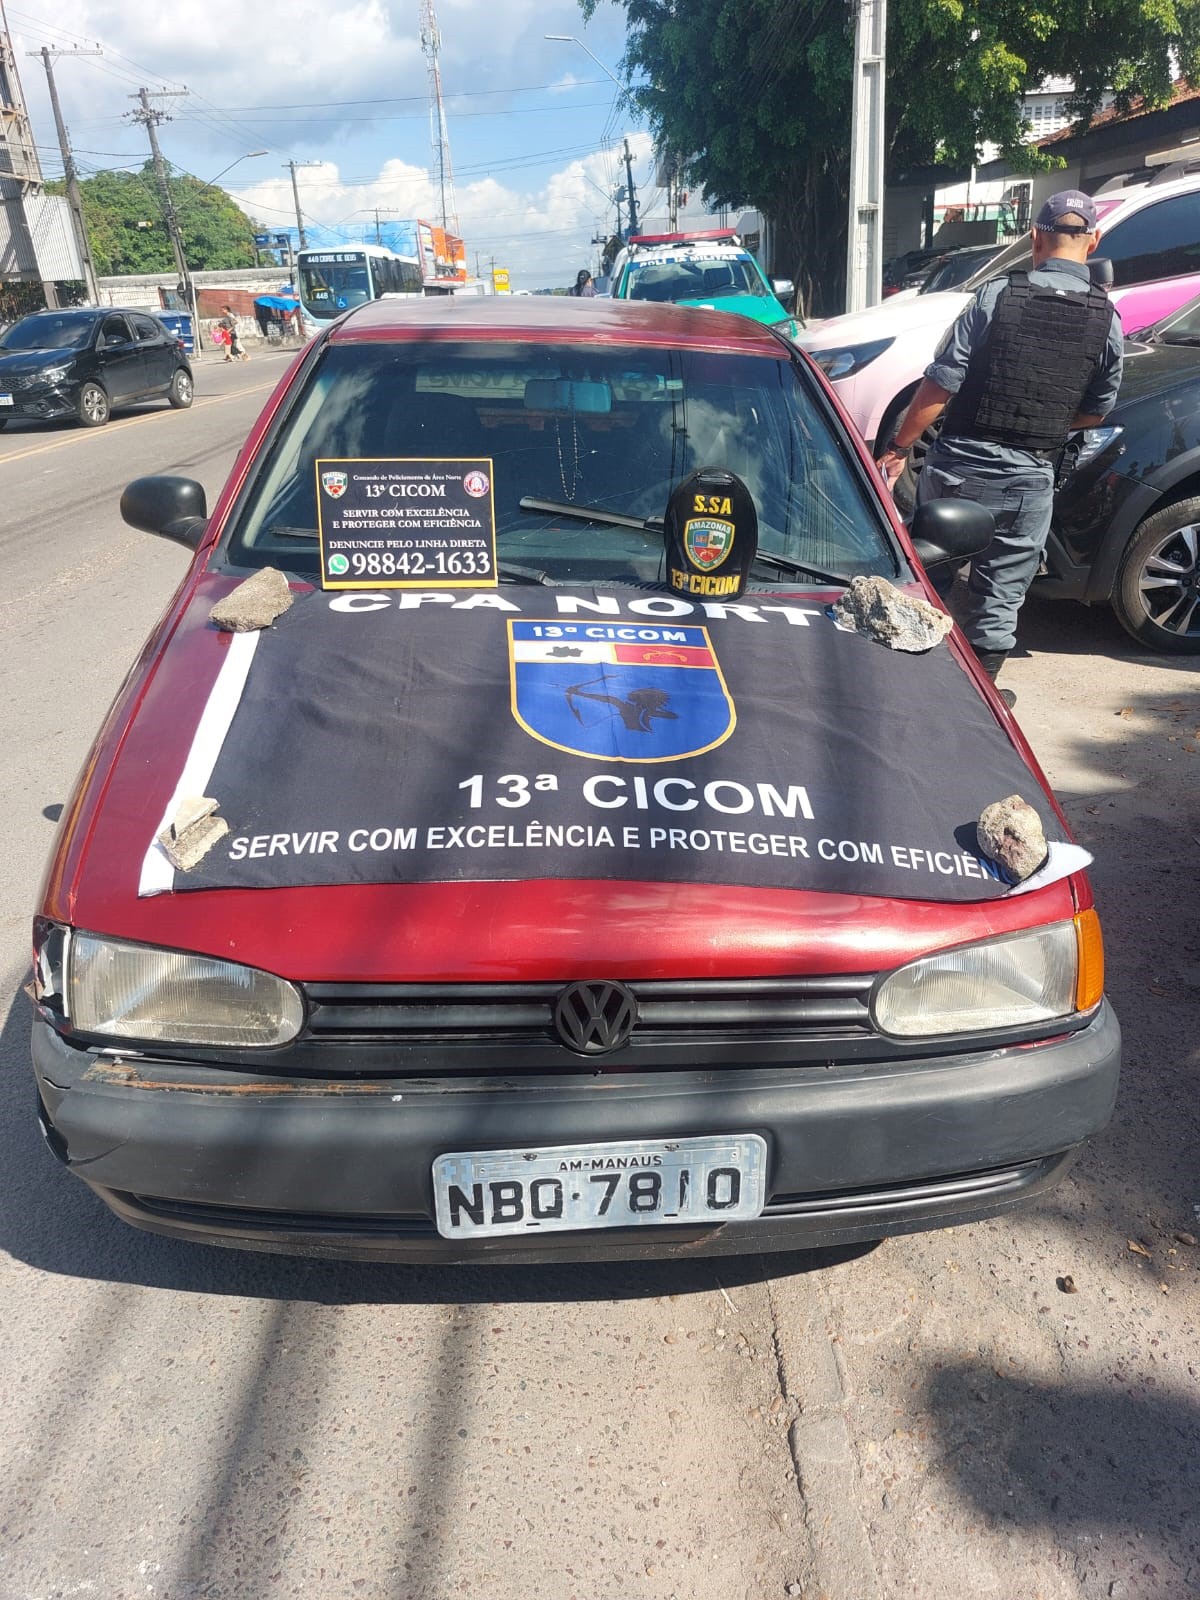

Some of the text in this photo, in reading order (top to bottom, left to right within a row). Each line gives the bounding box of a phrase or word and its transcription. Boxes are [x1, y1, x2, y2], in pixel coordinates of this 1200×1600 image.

[690, 254, 738, 262] MILITAR
[366, 484, 446, 497] 13ª CICOM
[343, 507, 470, 517] SERVIR COM EXCELÊNCIA
[333, 518, 482, 529] E PROTEGER COM EFICIÊNCIA
[689, 521, 732, 534] AMAZONAS
[329, 541, 384, 549] DENUNCIE
[415, 540, 448, 548] LINHA
[450, 539, 487, 548] DIRETA
[352, 552, 490, 575] 98842-1633
[672, 568, 741, 595] 13ª CICOM
[329, 593, 858, 633] CPA NORT
[533, 626, 686, 642] 13ª CICOM
[458, 774, 815, 820] 13ª CICOM
[228, 821, 1004, 882] SERVIR COM EXCELÊNCIA E PROTEGER COM EFICIÊN
[559, 1155, 663, 1172] AM-MANAUS
